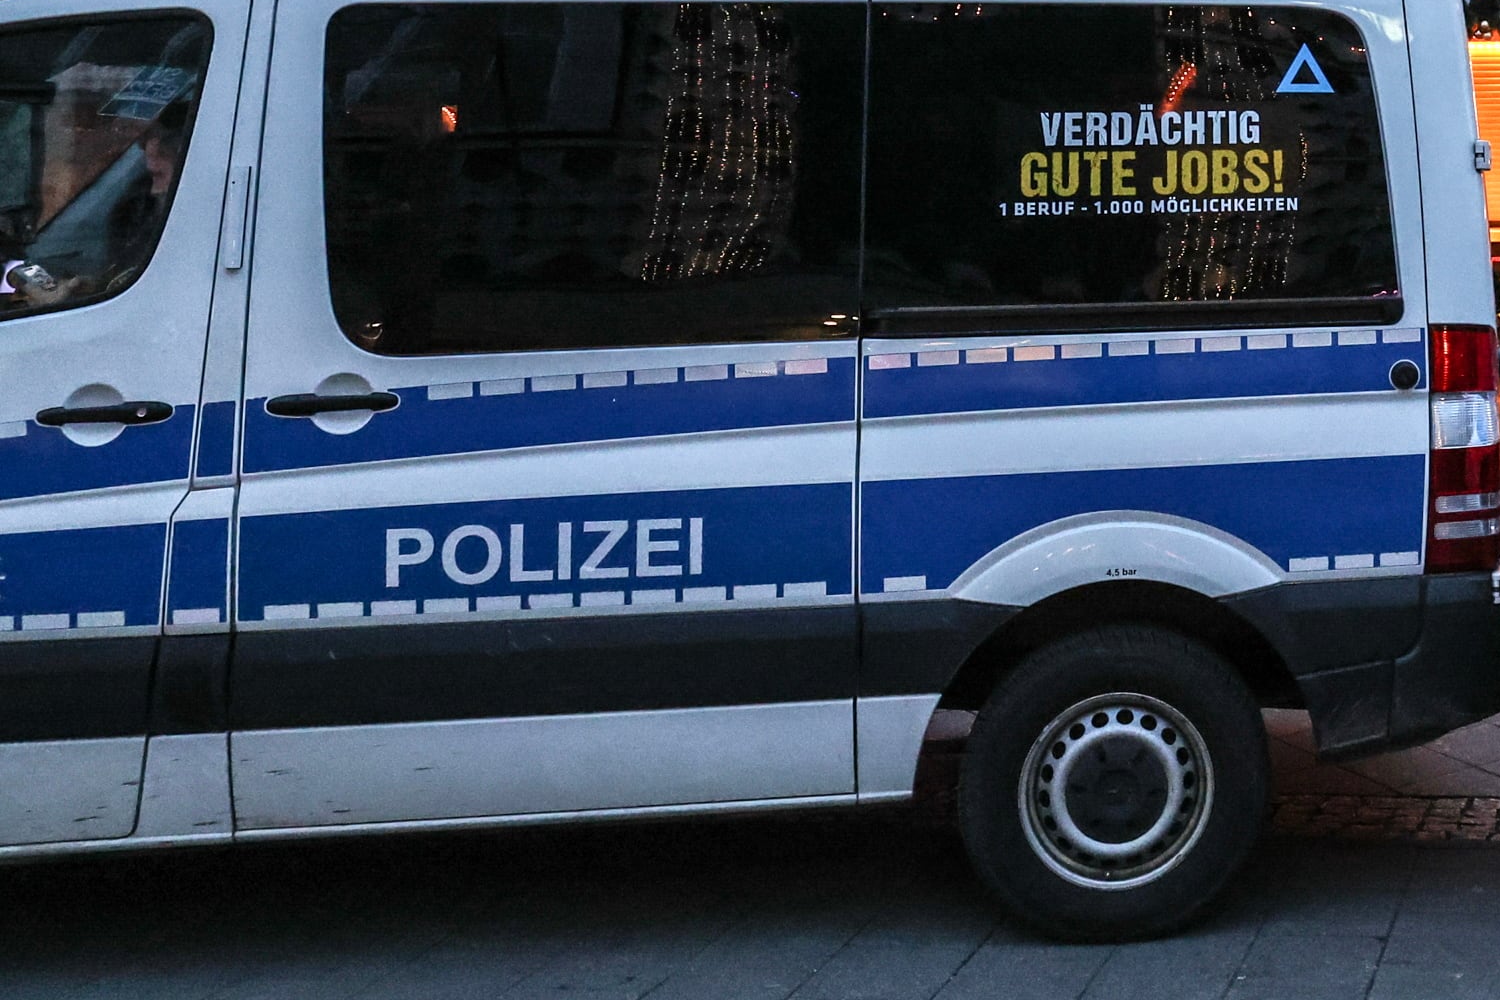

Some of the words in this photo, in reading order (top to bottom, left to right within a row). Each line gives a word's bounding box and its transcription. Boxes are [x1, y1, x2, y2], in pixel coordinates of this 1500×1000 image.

[1040, 103, 1261, 147] VERDÄCHTIG
[1020, 150, 1137, 198] GUTE
[1152, 150, 1284, 195] JOBS!
[999, 202, 1007, 217] 1
[1014, 201, 1075, 216] BERUF
[1094, 200, 1144, 215] 1.000
[1151, 196, 1298, 214] MÖGLICHKEITEN
[385, 517, 703, 588] POLIZEI
[1122, 567, 1137, 576] bar
